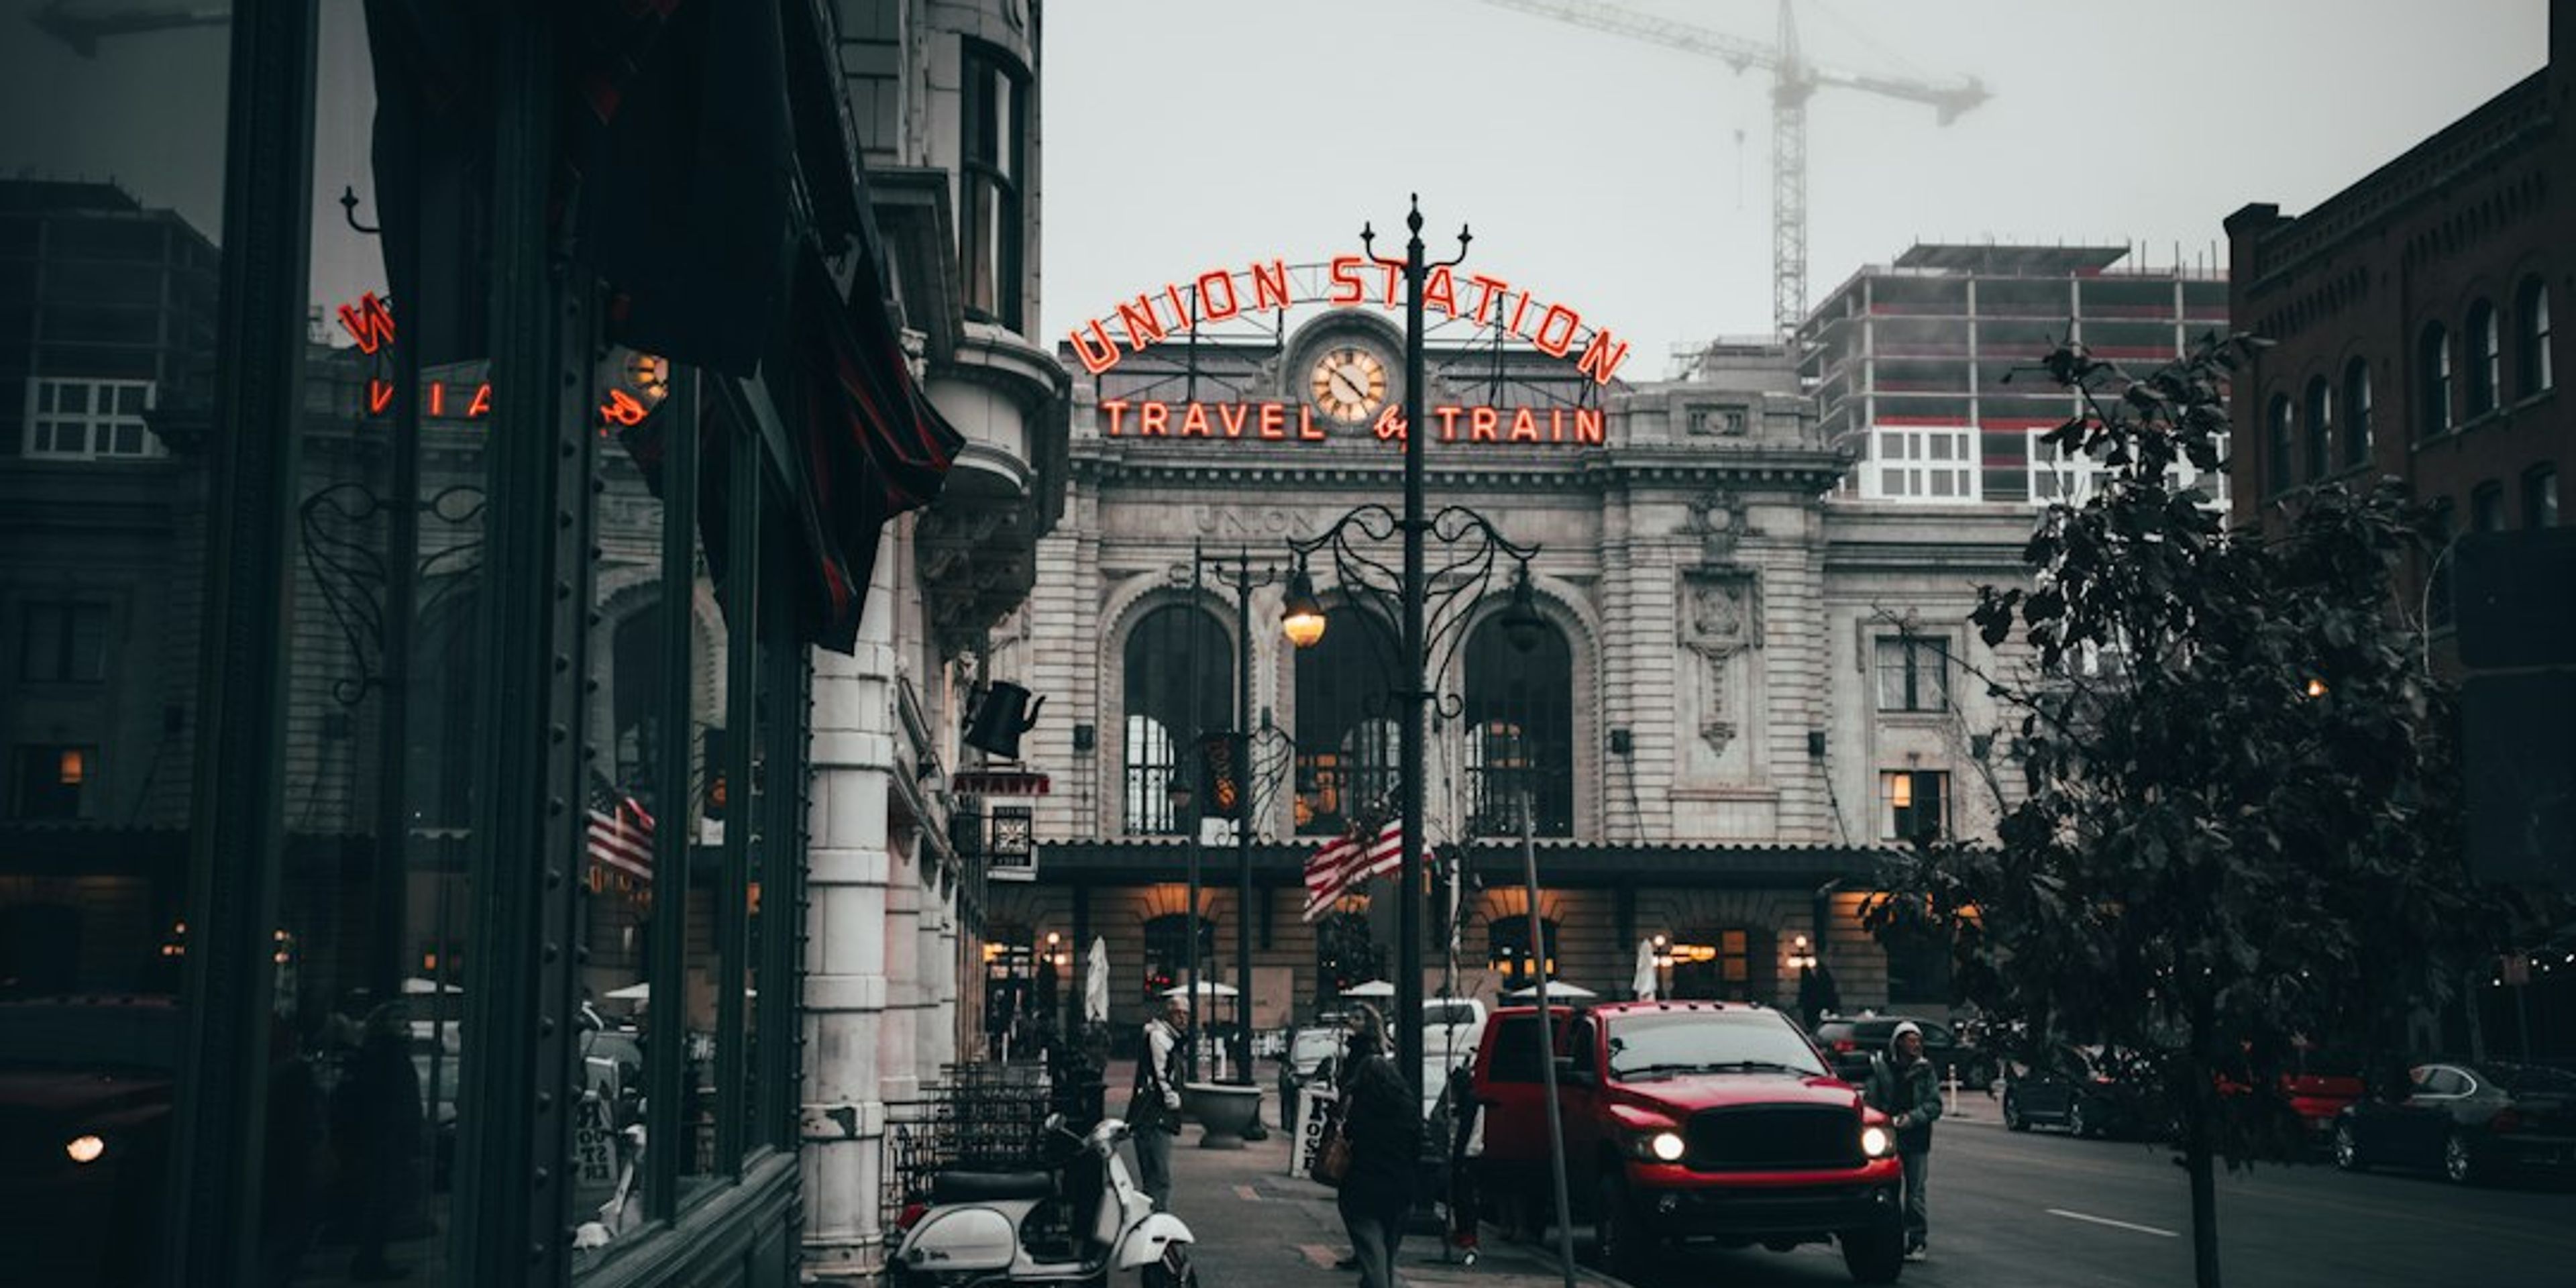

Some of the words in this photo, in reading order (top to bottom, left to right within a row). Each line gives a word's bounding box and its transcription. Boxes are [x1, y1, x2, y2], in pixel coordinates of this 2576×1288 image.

[1069, 258, 1291, 374] UNION
[1330, 254, 1629, 384] STATION
[1102, 398, 1324, 440] TRAVEL
[1435, 405, 1604, 443] TRAIN
[1194, 508, 1317, 534] UNION
